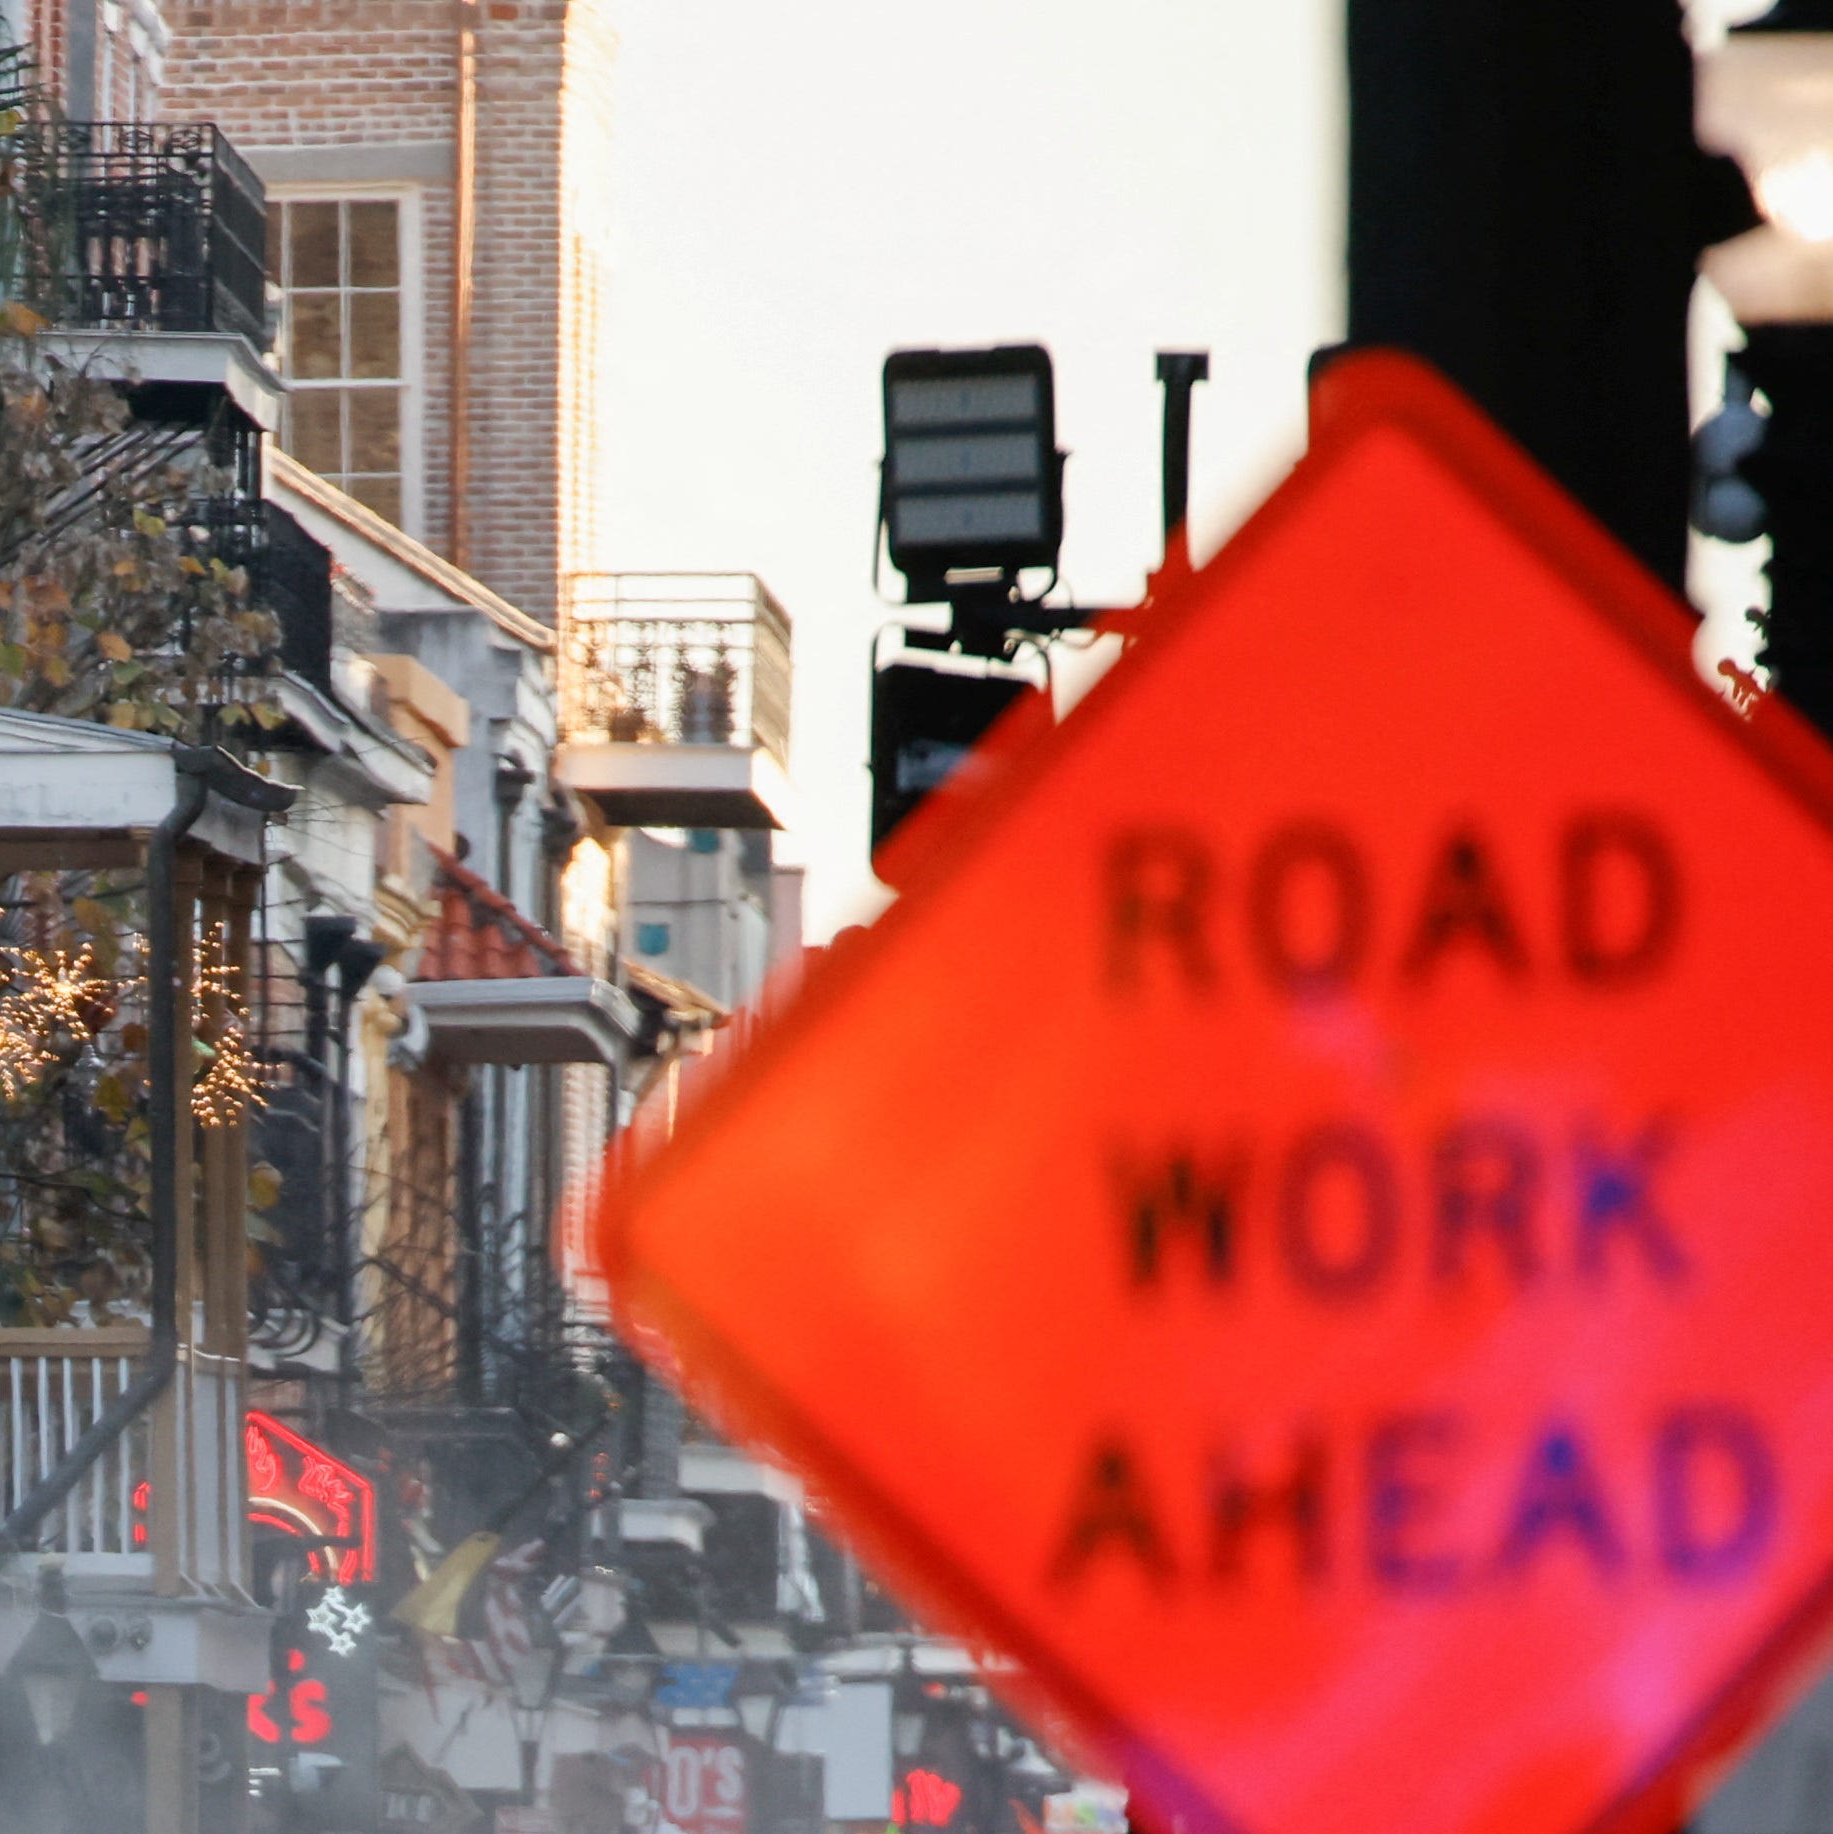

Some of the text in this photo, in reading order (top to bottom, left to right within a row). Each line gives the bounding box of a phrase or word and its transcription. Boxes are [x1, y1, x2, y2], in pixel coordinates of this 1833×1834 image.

[1101, 808, 1685, 1000] ROAD
[1105, 1108, 1688, 1308] WORK
[1046, 1403, 1779, 1588] AHEAD
